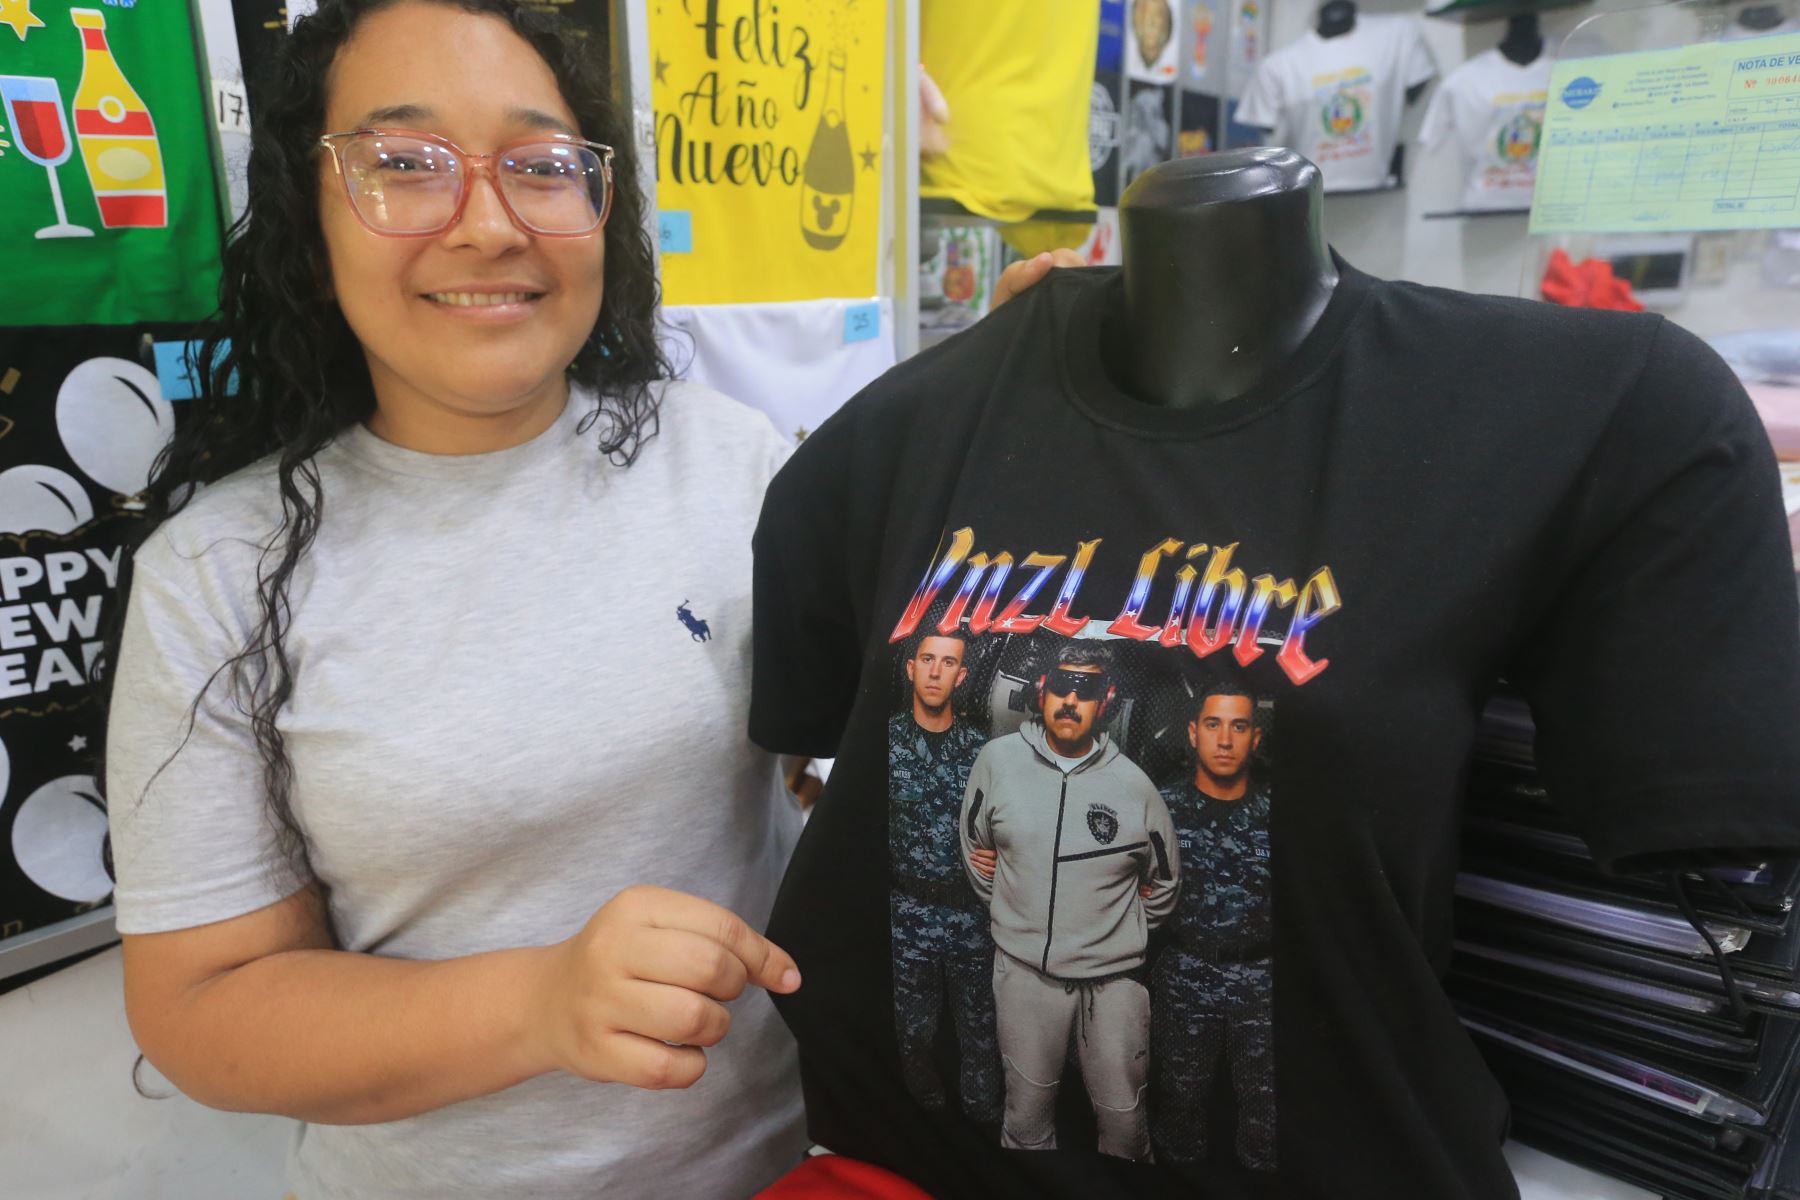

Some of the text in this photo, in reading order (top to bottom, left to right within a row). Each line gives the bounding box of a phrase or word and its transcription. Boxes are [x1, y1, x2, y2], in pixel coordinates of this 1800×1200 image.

[683, 0, 815, 110] Feliz
[1738, 59, 1766, 71] NOTA
[1769, 56, 1785, 67] DE
[219, 91, 244, 125] 17
[679, 71, 779, 129] Año
[0, 544, 122, 602] PPY
[1106, 536, 1343, 686] Libre
